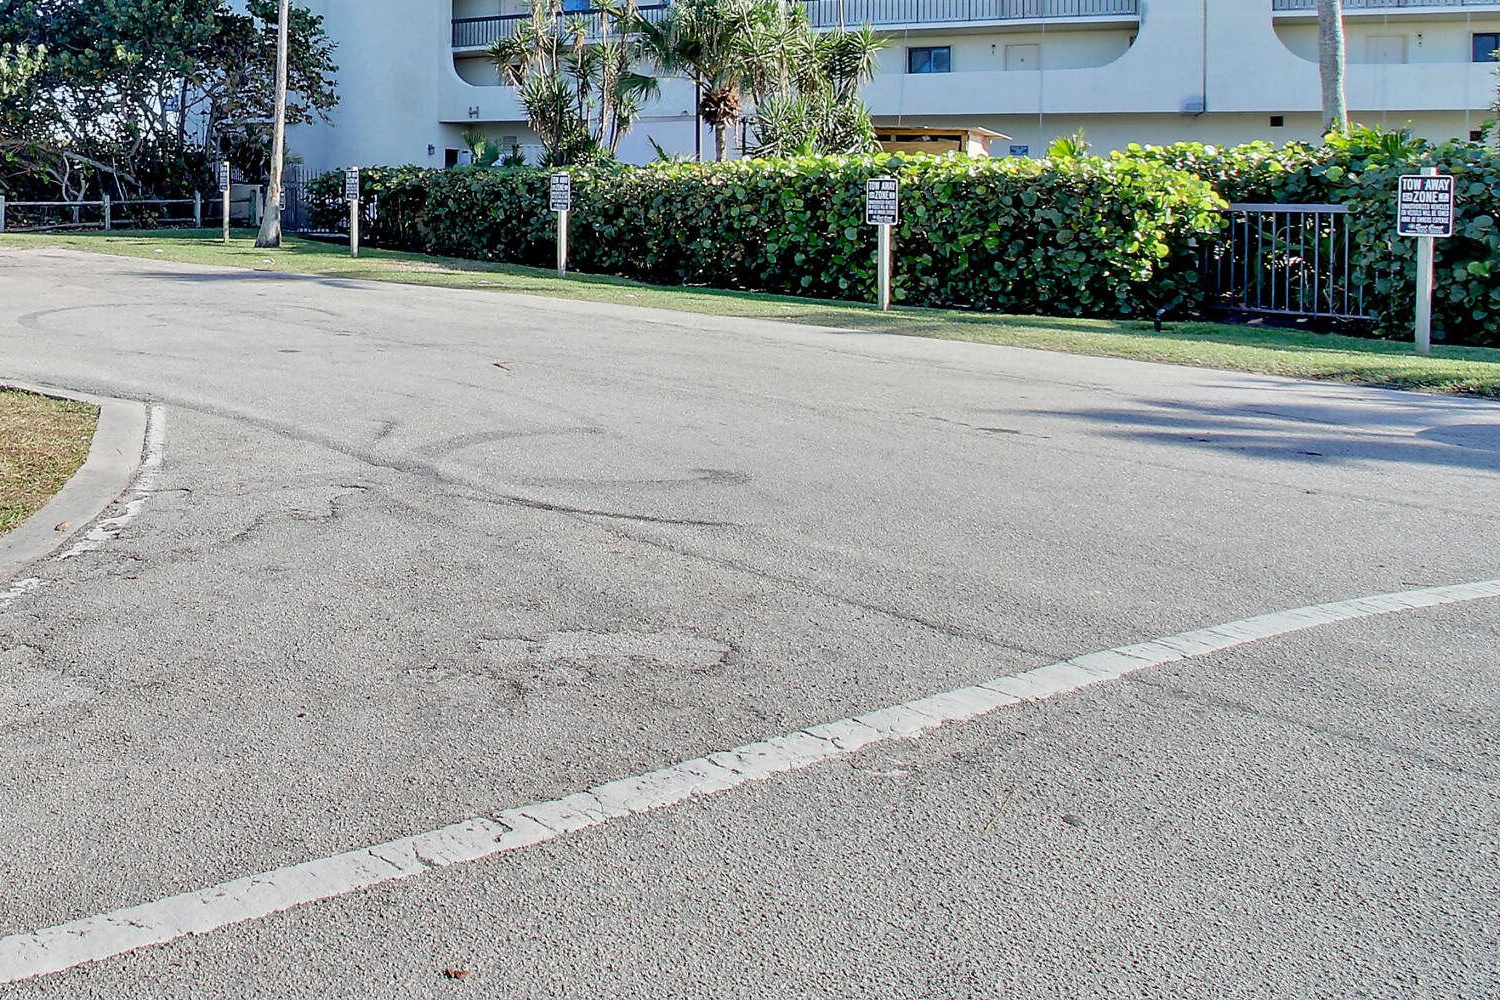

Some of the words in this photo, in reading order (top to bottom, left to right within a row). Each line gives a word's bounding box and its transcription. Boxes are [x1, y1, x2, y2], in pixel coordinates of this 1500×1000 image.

[1402, 178, 1422, 190] TOW
[1424, 178, 1450, 190] AWAY
[1412, 191, 1438, 203] ZONE
